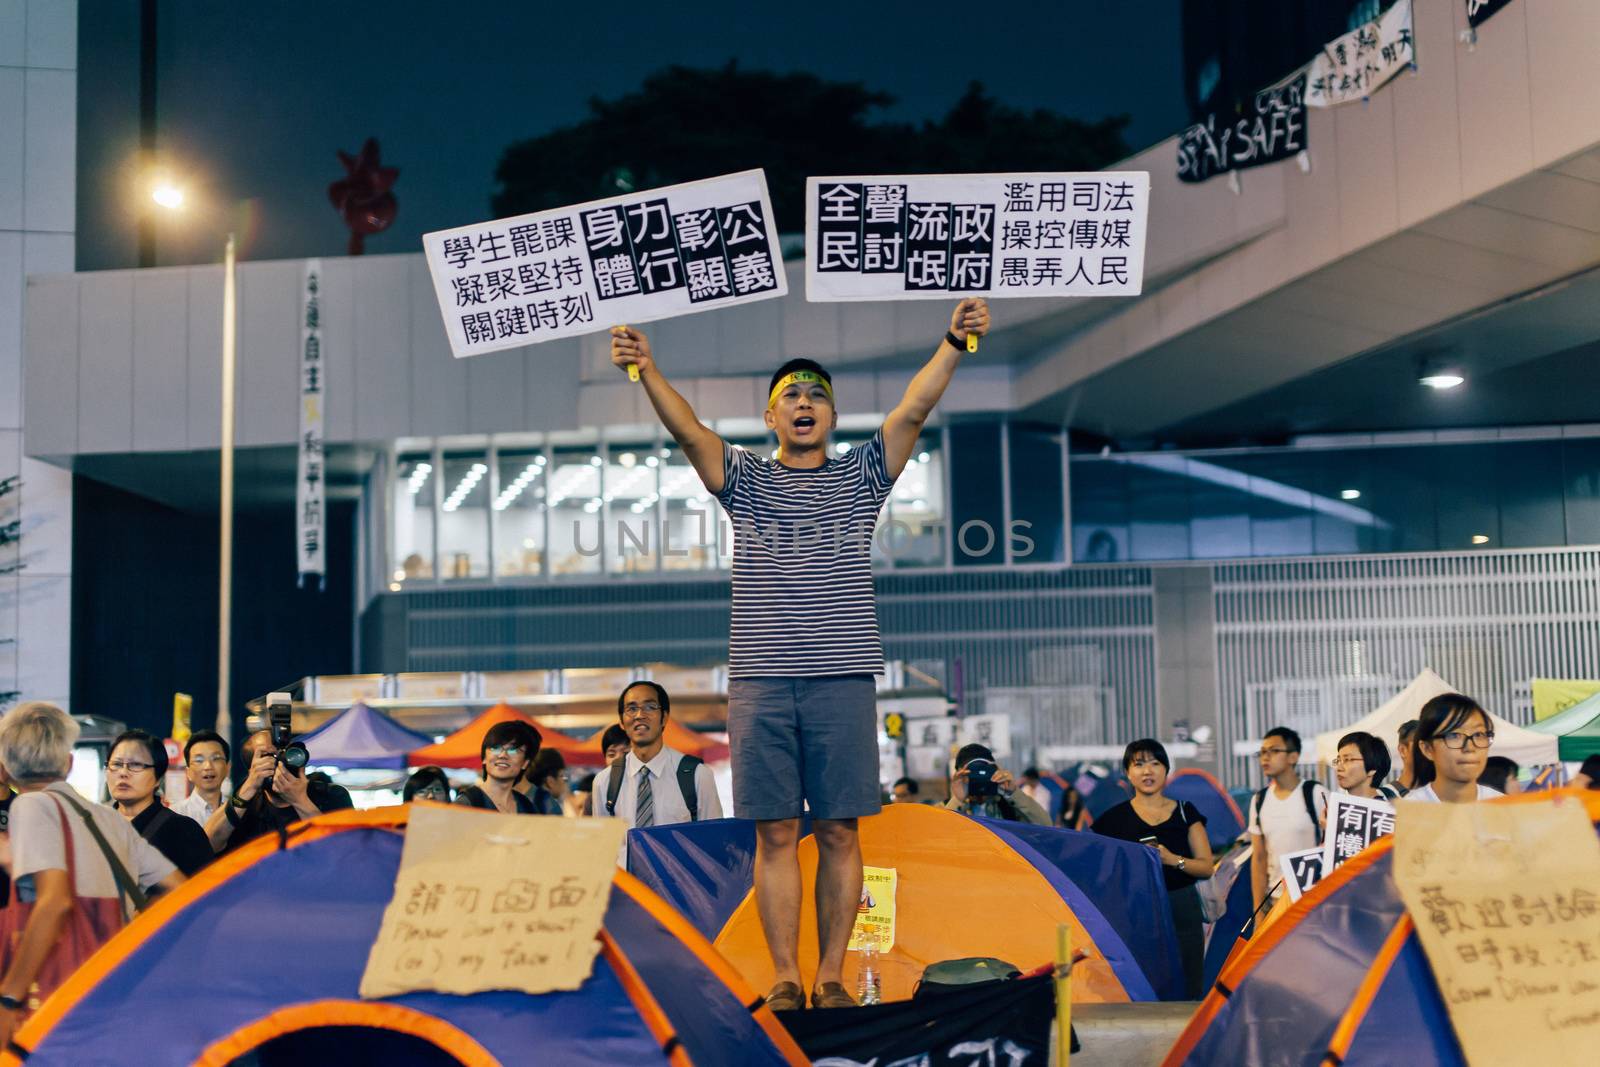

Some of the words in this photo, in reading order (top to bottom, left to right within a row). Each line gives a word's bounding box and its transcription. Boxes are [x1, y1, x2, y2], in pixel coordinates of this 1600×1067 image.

[1233, 106, 1302, 161] SAFE
[819, 184, 862, 270] 全民
[863, 184, 906, 271] 聲討
[1003, 181, 1135, 213] 濫用司法
[443, 216, 577, 269] 學生罷課
[584, 207, 640, 299] 身體
[628, 202, 680, 291] 力行
[722, 203, 775, 293] 公義
[907, 202, 949, 288] 流氓
[950, 204, 994, 289] 政府
[1000, 218, 1132, 250] 操控傳媒
[451, 255, 584, 307] 凝聚堅持
[999, 256, 1129, 287] 愚弄人民
[461, 292, 595, 345] 關鍵時刻
